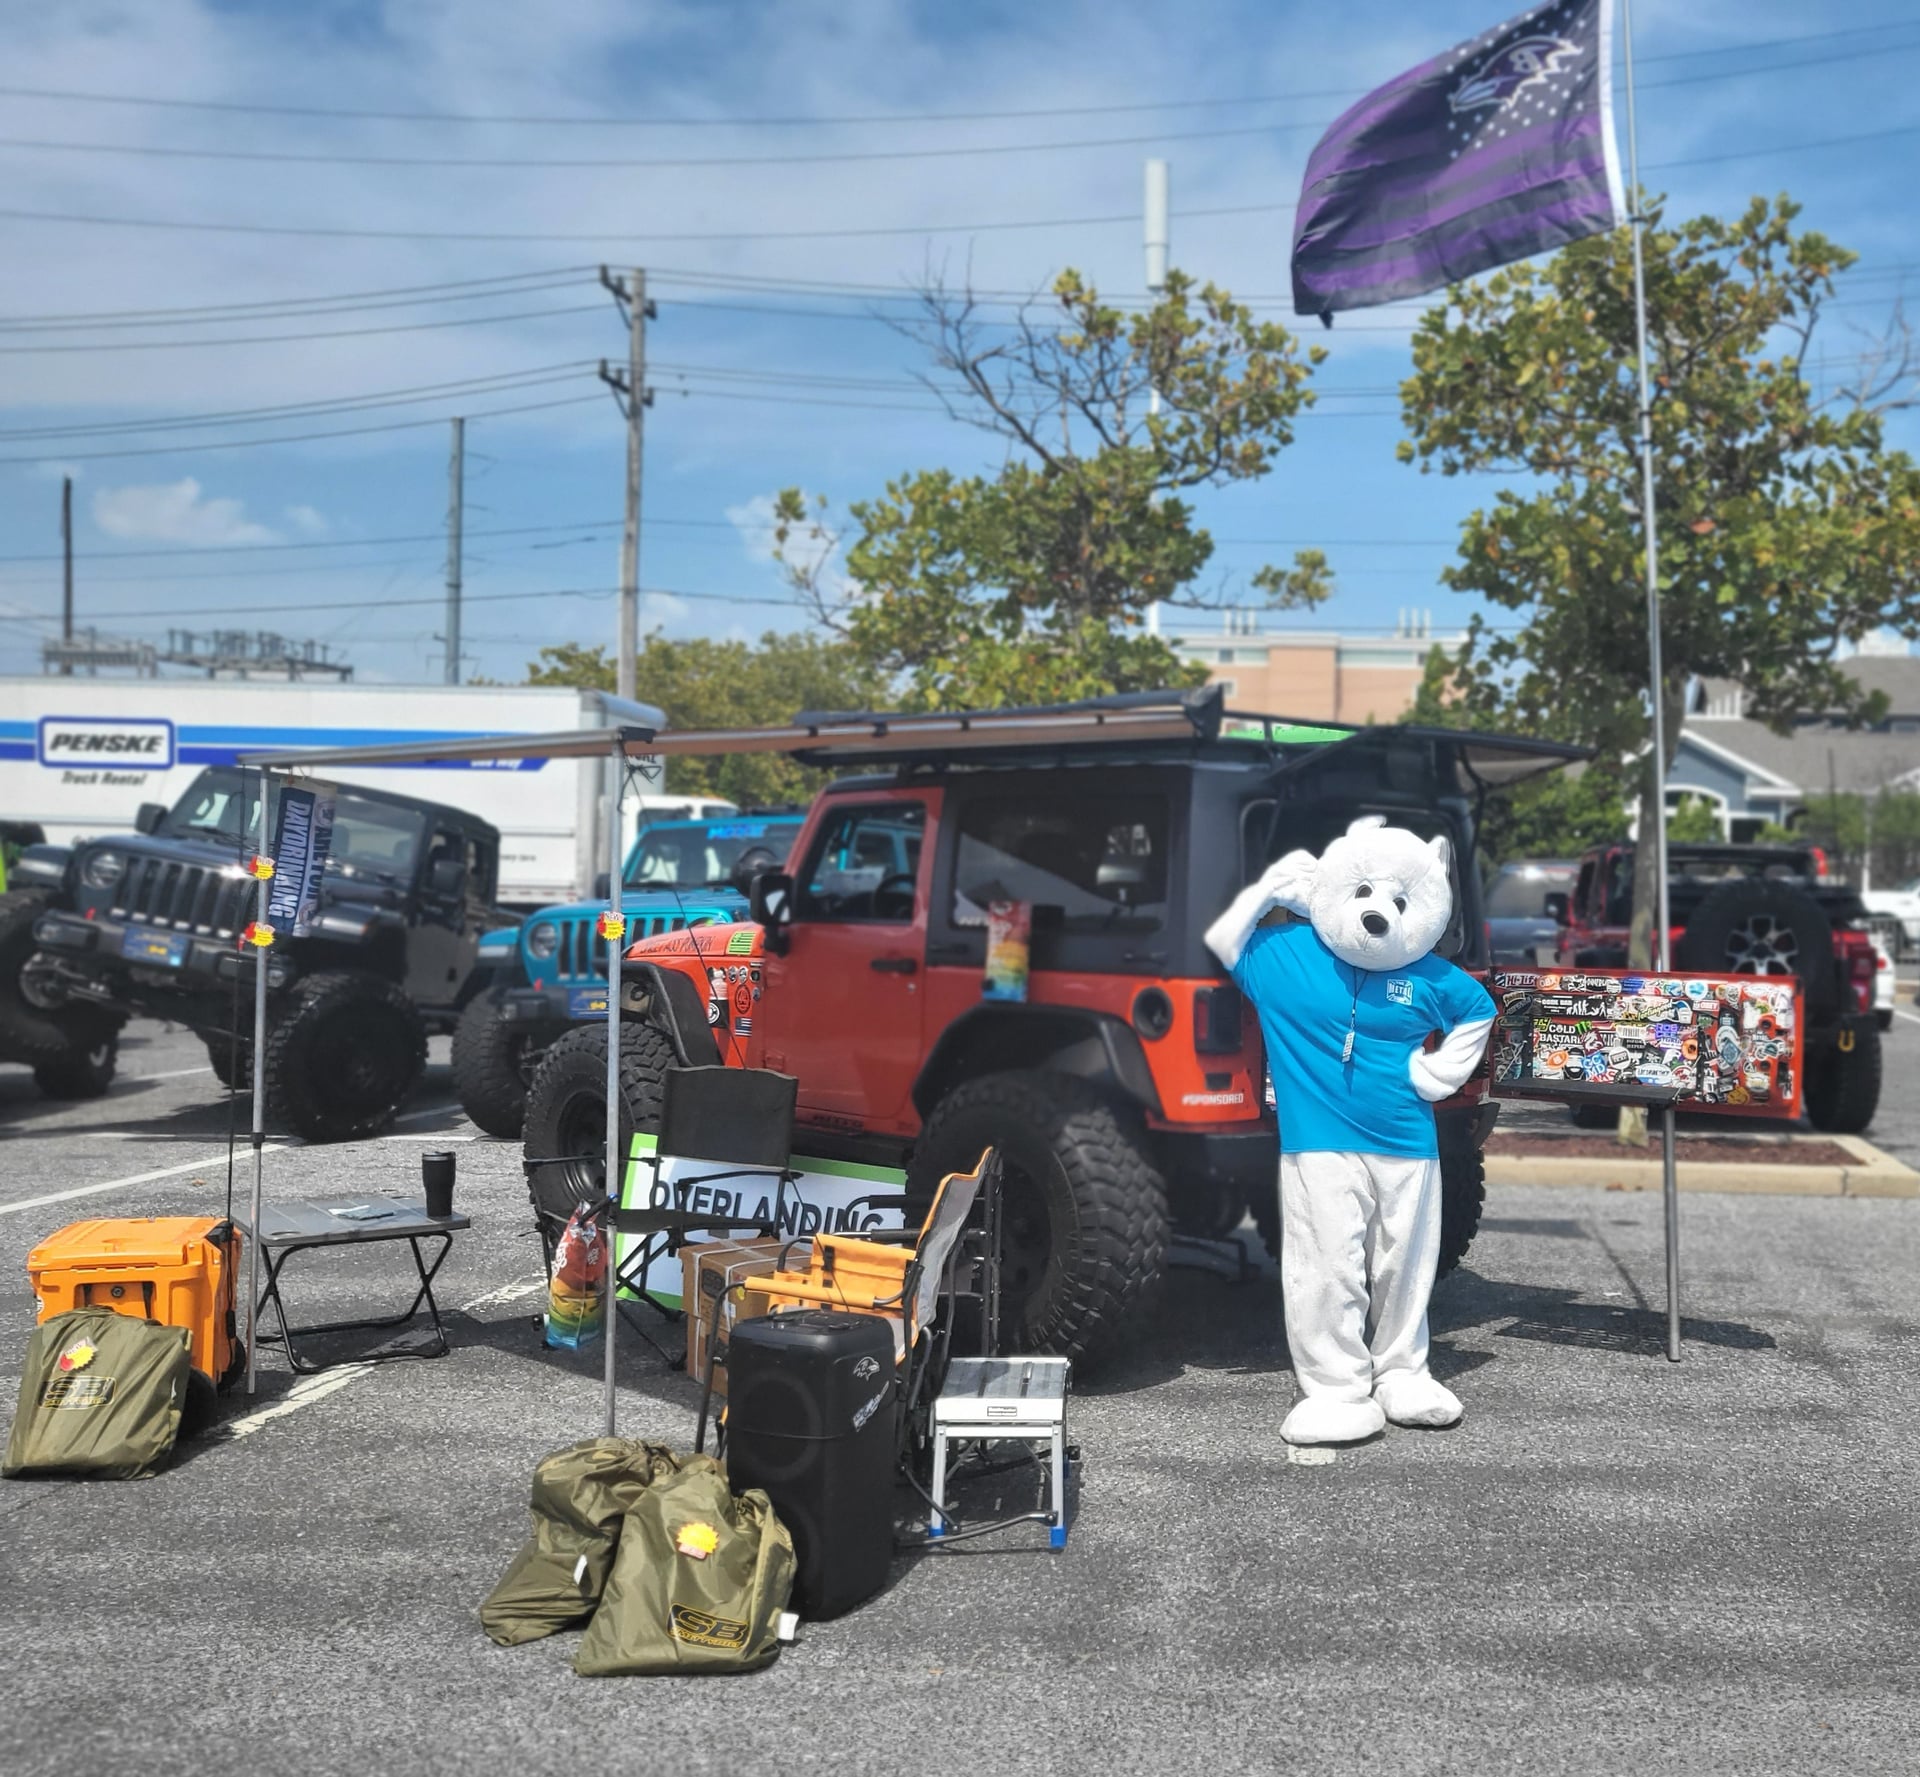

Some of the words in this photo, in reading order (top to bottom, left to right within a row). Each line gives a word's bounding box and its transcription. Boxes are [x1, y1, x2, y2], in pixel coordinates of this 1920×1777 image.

[49, 733, 163, 753] PENSKE
[62, 771, 98, 784] Truck
[101, 772, 147, 785] Rental
[268, 799, 311, 919] DAYDRINKING
[1549, 1024, 1576, 1034] COLD
[677, 1610, 747, 1641] SB
